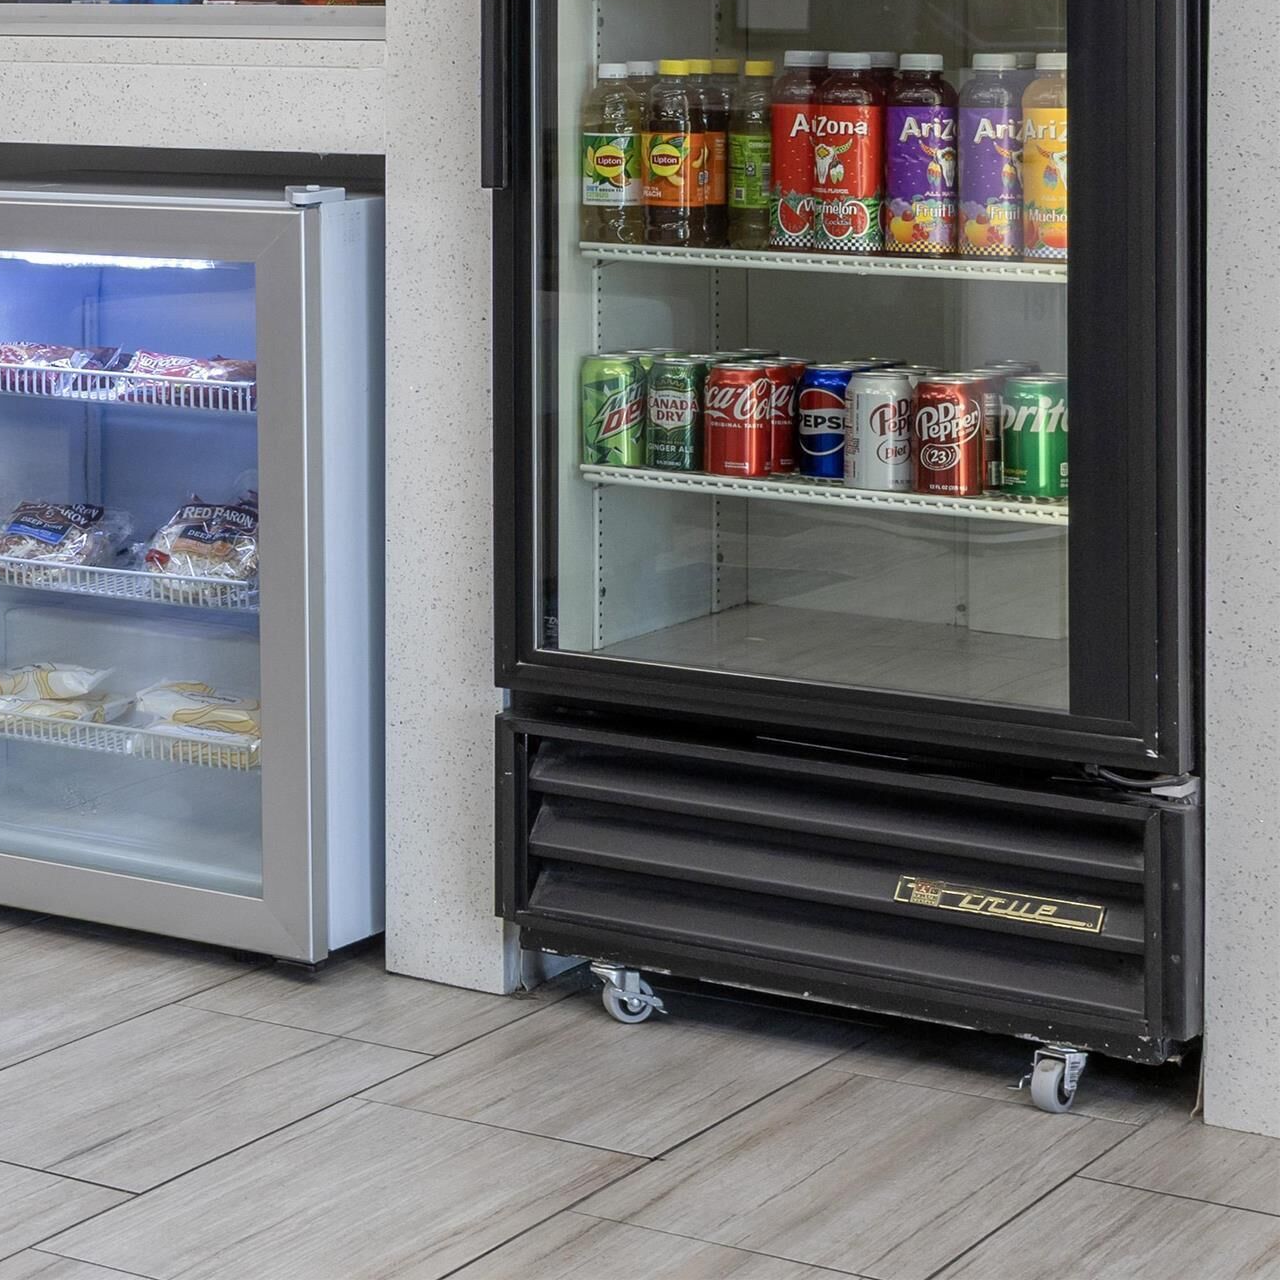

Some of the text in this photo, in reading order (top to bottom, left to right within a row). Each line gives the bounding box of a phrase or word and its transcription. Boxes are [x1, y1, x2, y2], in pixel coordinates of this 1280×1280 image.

[899, 116, 956, 143] AriZ
[597, 158, 623, 166] Lipton
[653, 156, 678, 165] Lipton
[649, 396, 699, 412] CANADA
[938, 402, 962, 419] Dr
[656, 409, 684, 422] DRY
[918, 406, 979, 441] Pepper
[649, 443, 694, 453] GINGER ALE
[885, 445, 907, 460] Diet
[930, 449, 947, 463] 23
[182, 505, 254, 528] RED BARON
